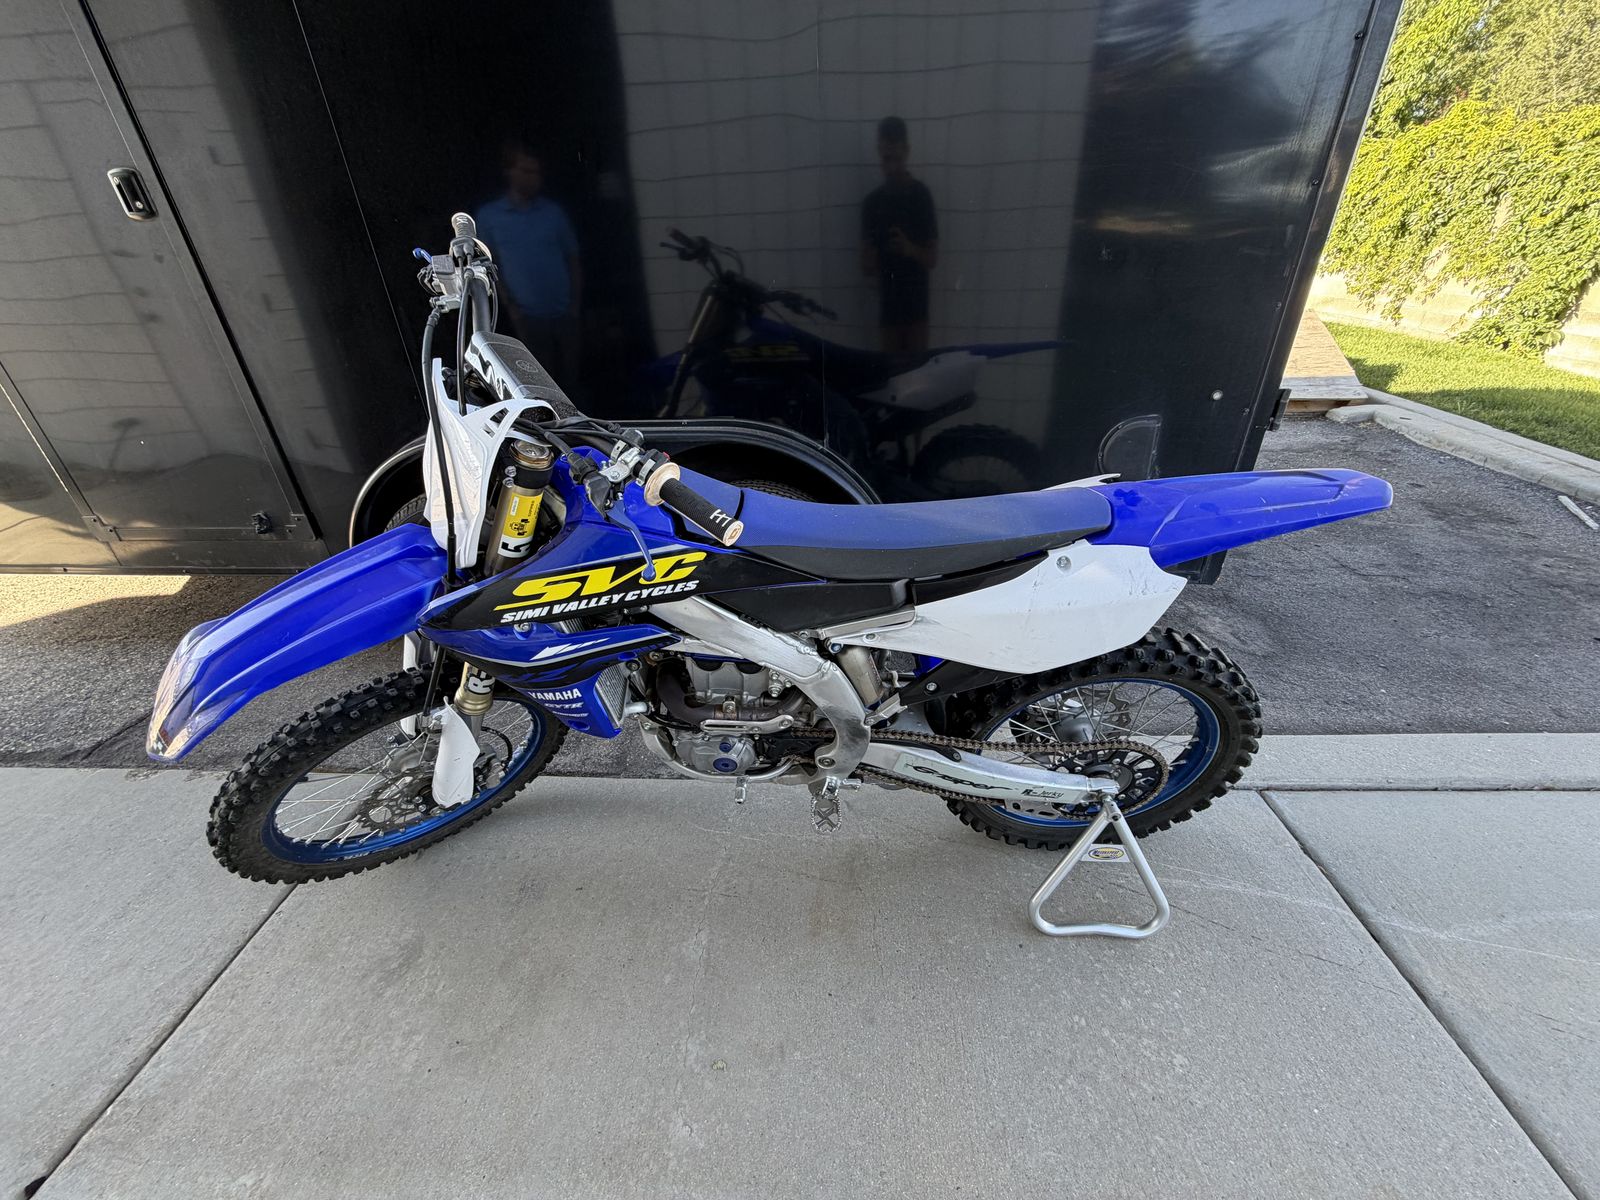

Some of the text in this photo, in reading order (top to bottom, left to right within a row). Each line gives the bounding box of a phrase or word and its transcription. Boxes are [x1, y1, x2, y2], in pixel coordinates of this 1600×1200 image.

[493, 552, 707, 611] SVC
[500, 580, 700, 623] SIMI VALLEY CYCLES
[528, 687, 582, 701] YAMAHA
